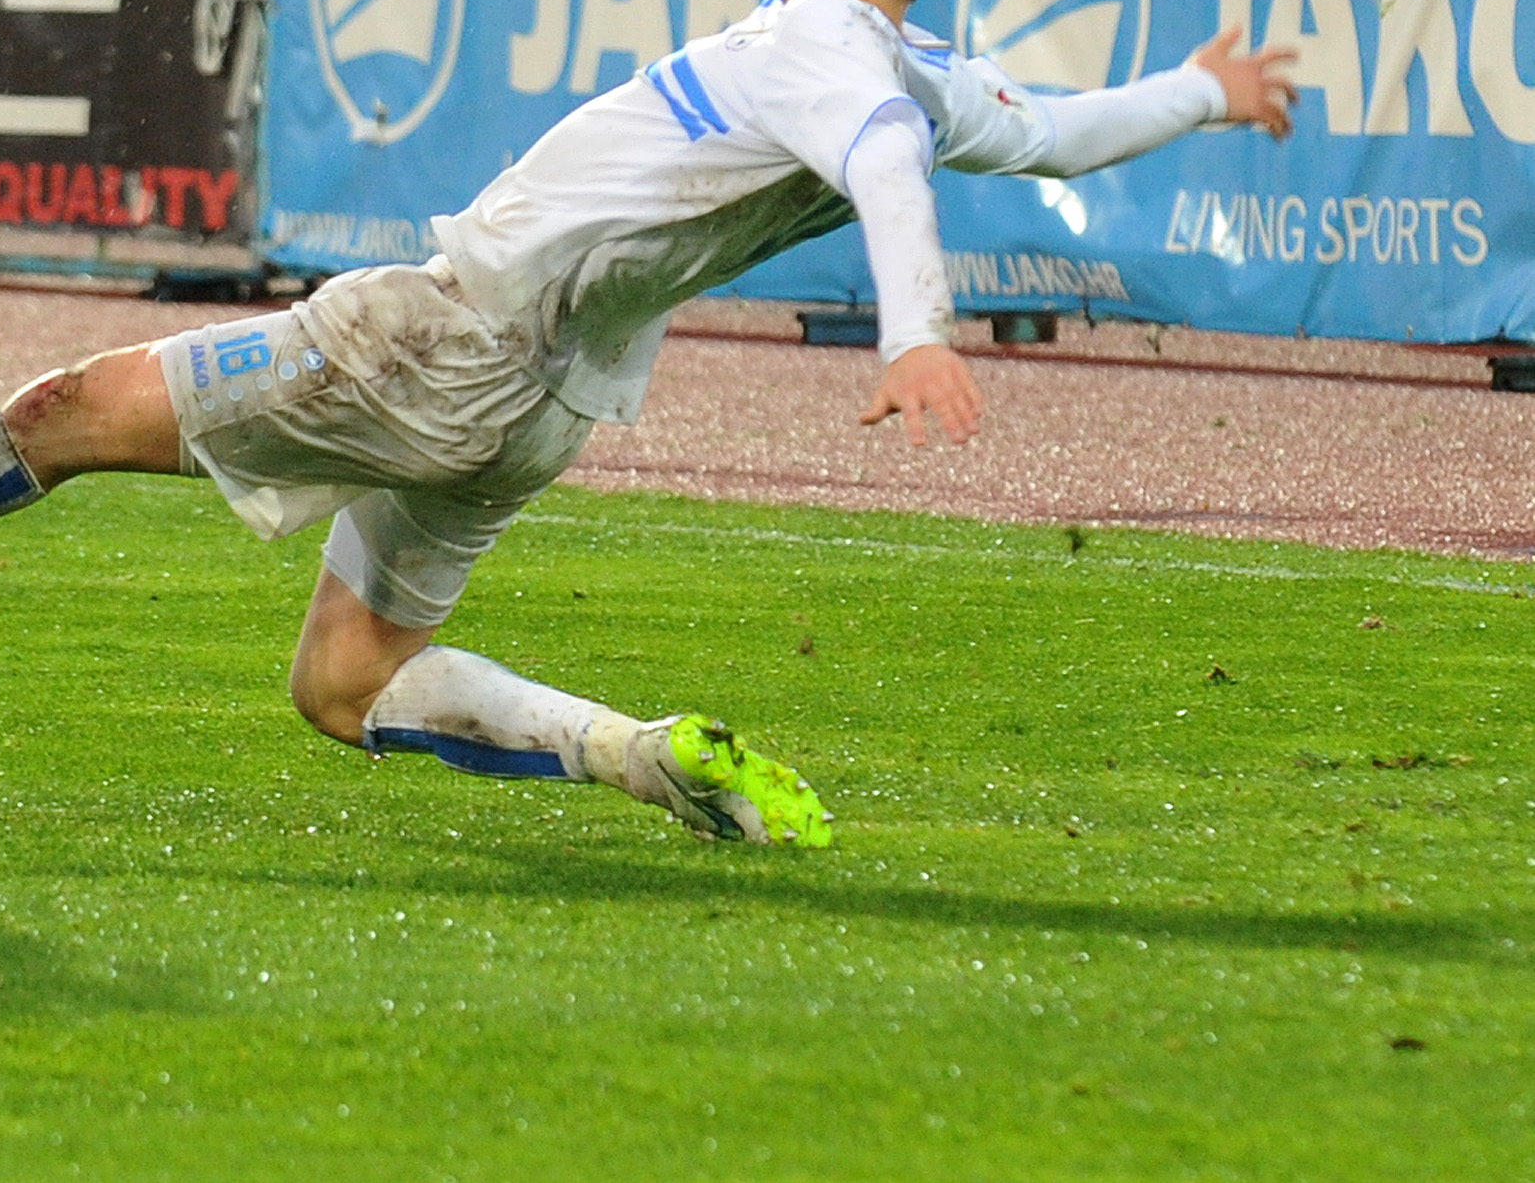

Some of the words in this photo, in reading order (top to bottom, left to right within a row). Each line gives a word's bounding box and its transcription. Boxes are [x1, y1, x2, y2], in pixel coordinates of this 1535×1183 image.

[1166, 189, 1307, 264] LIVING
[1315, 196, 1490, 267] SPORTS
[214, 332, 272, 377] 18
